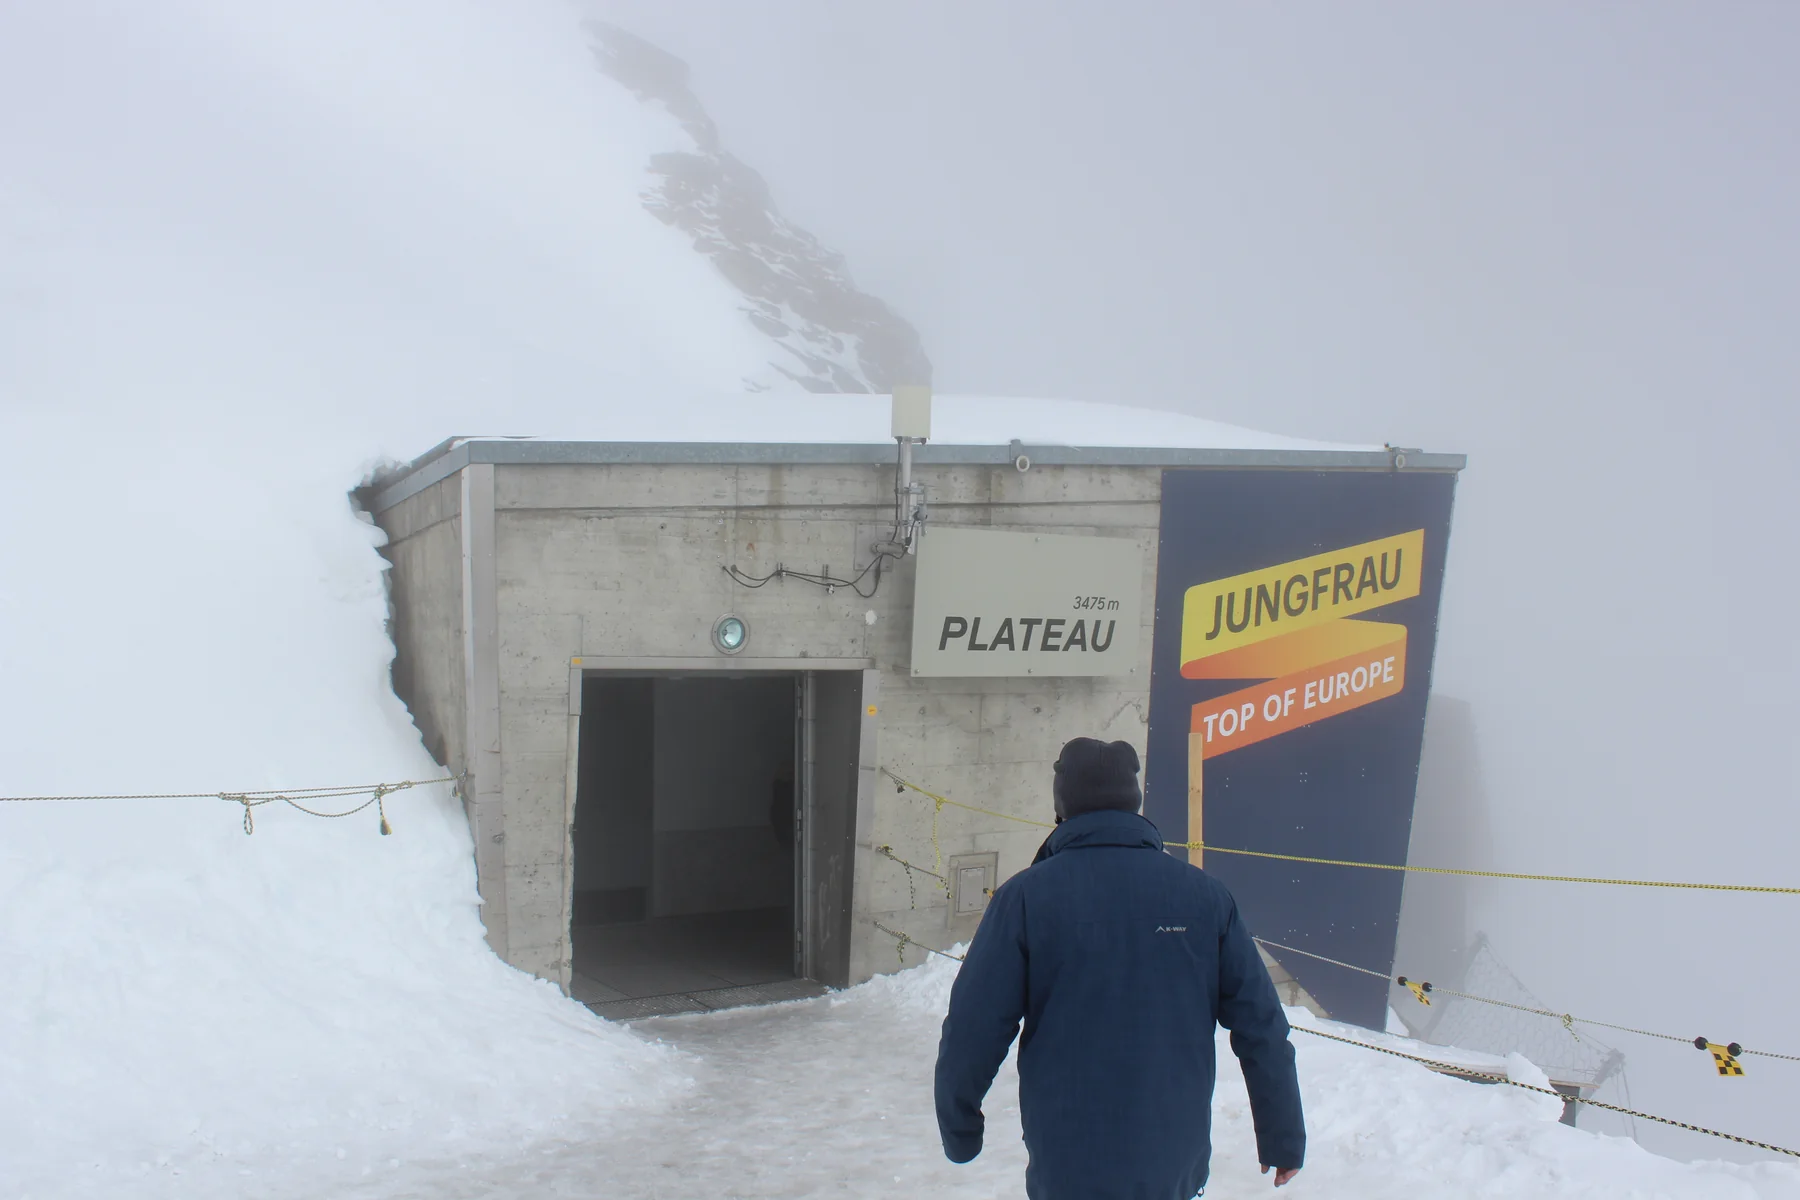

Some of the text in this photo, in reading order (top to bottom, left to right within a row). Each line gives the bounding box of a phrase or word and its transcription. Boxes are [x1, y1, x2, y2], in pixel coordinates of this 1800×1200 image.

[1073, 596, 1120, 611] 3475 m
[1205, 548, 1403, 641] JUNGFRAU
[938, 616, 1116, 652] PLATEAU
[1203, 656, 1395, 743] TOP OF EUROPE
